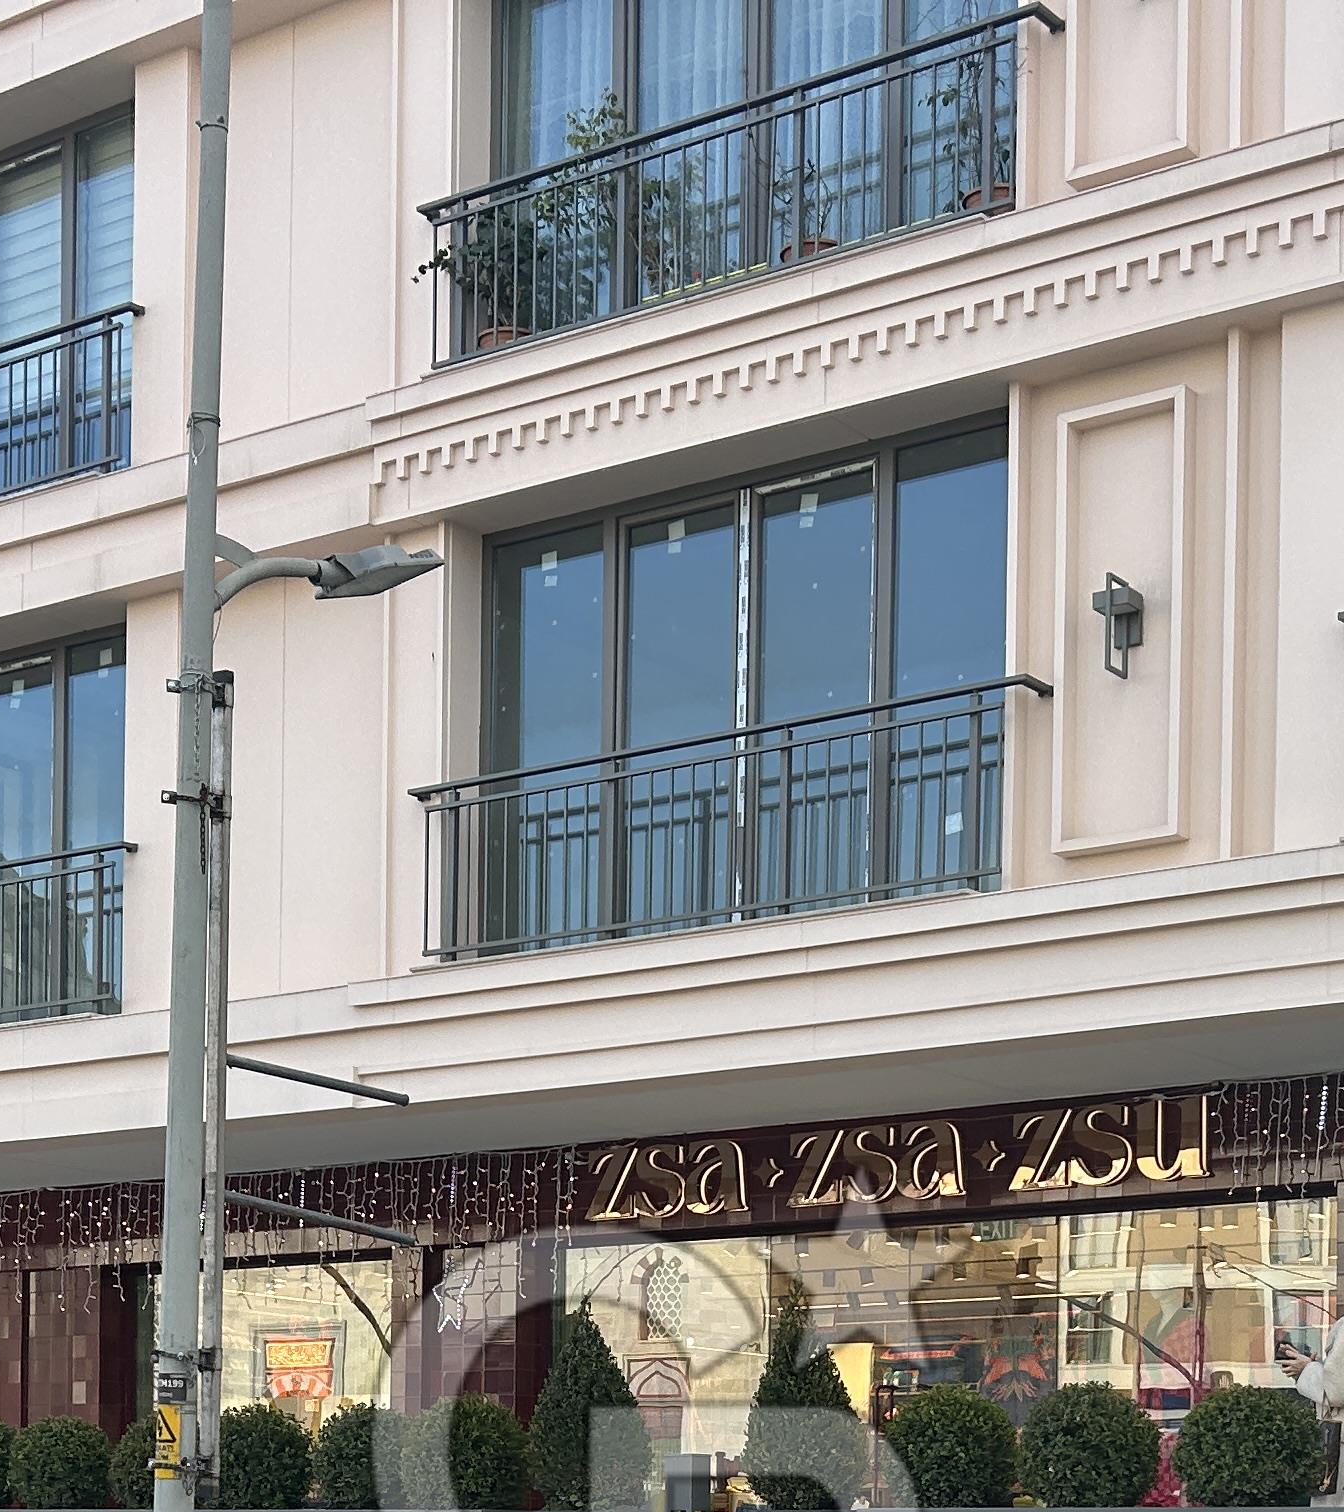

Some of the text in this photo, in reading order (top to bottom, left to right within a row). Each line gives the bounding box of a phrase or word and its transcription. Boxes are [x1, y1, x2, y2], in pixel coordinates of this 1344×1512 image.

[585, 1094, 1213, 1221] zsa zsa zsu
